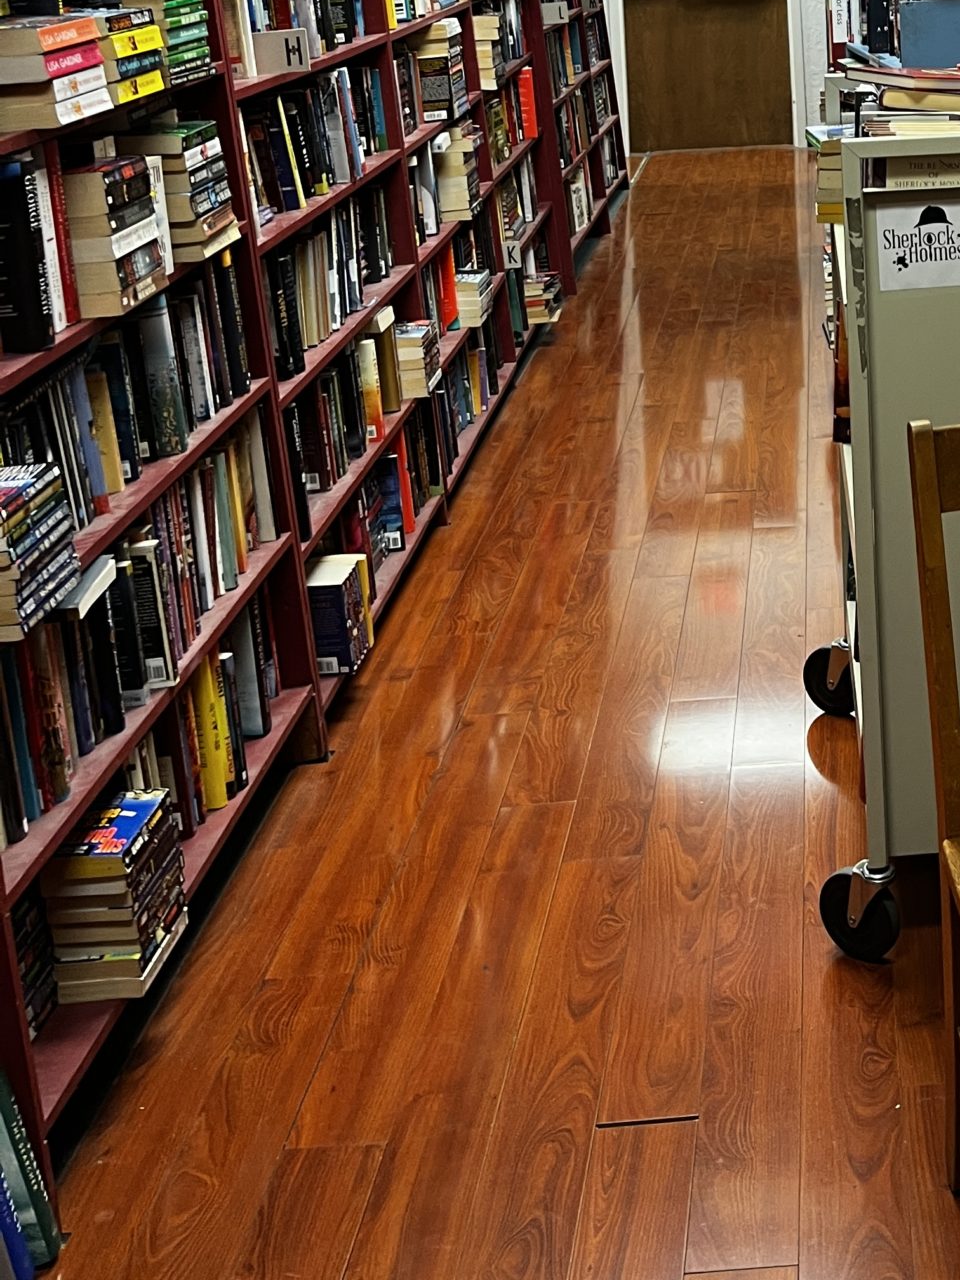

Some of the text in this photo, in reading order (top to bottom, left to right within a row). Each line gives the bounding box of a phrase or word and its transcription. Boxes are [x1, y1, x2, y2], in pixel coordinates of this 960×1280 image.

[558, 8, 565, 20] L
[40, 34, 55, 46] LISA
[284, 37, 303, 67] H
[46, 62, 58, 72] LISA
[507, 244, 517, 265] K
[97, 838, 127, 853] SUE
